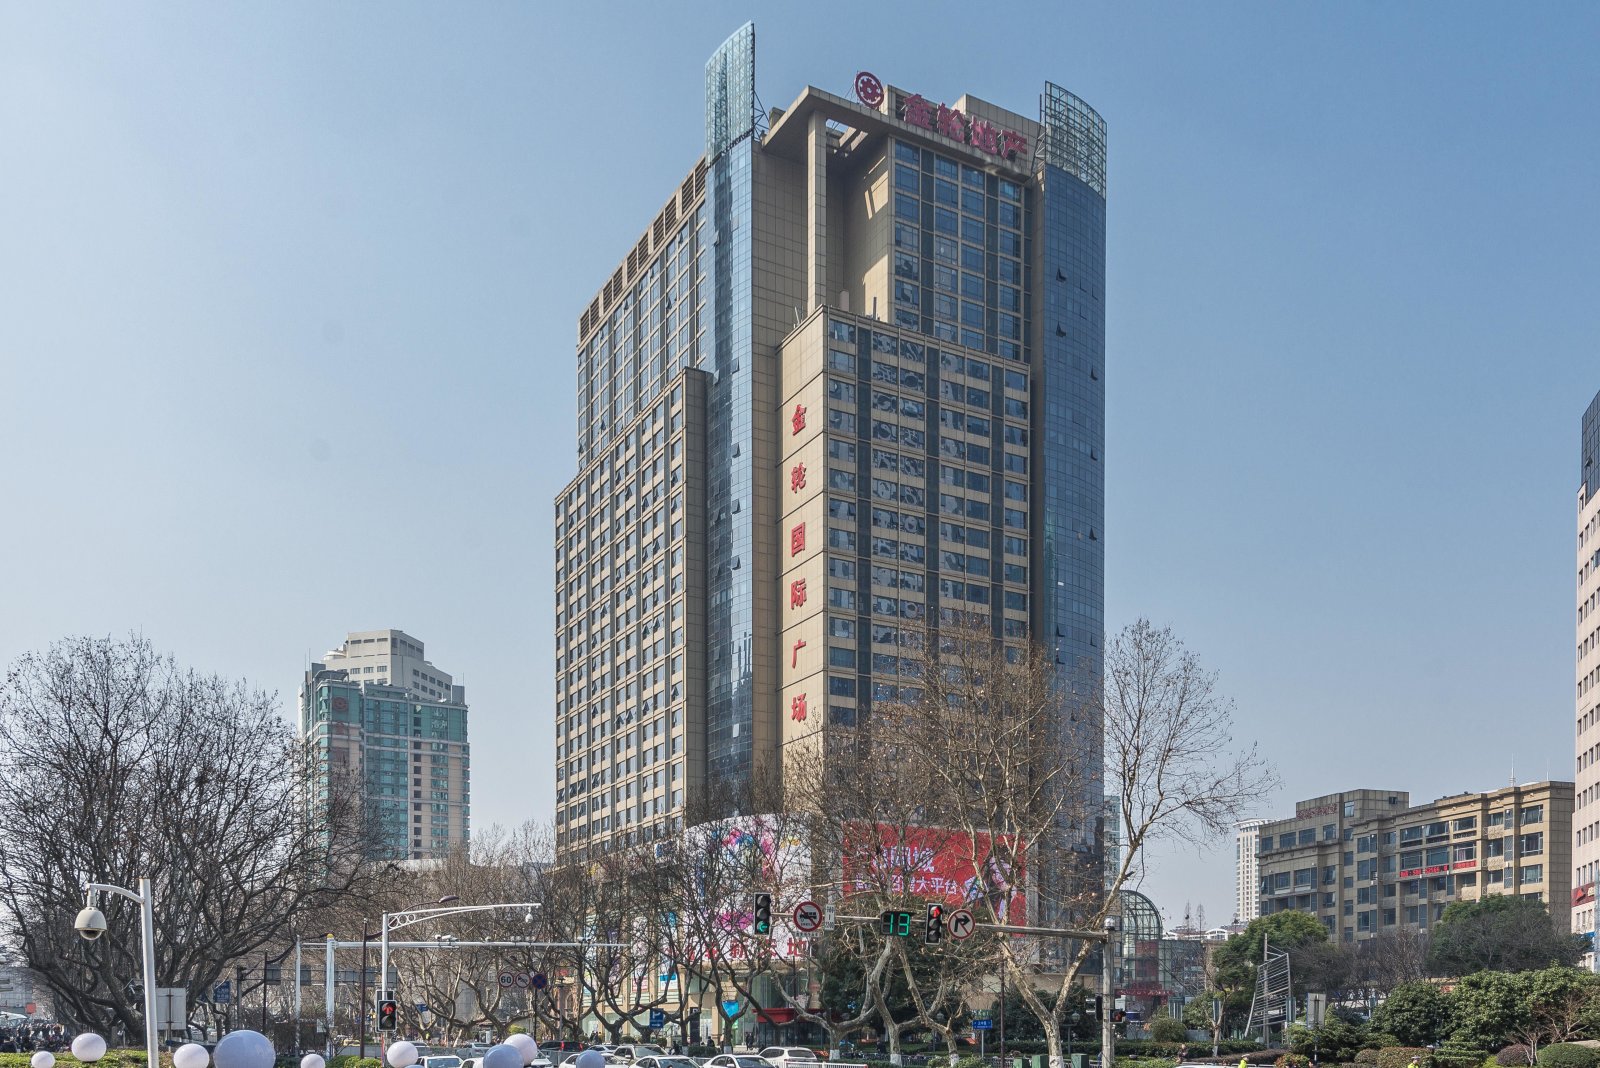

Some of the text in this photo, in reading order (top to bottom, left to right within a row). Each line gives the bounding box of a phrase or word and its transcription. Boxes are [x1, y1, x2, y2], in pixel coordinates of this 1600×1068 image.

[904, 93, 1028, 159] 金轮地产
[791, 404, 806, 722] 金轮国际广场
[889, 912, 910, 936] 13
